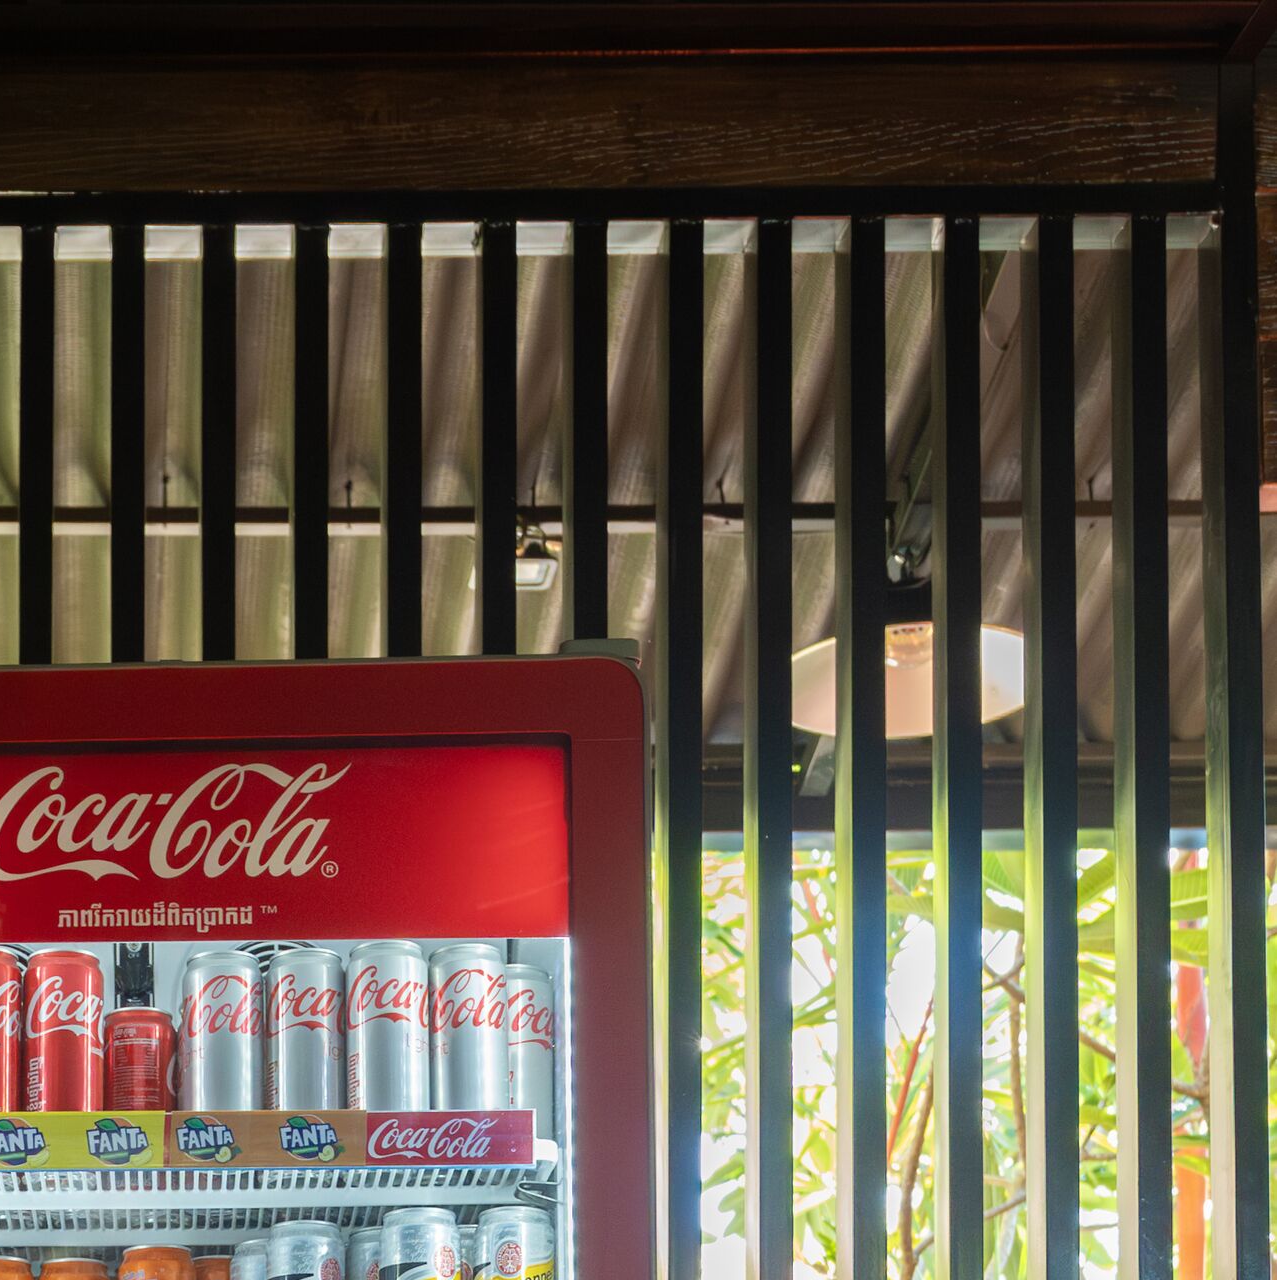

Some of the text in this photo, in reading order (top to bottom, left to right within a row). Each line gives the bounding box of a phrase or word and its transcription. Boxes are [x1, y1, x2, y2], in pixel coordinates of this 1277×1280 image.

[87, 1127, 148, 1156] FANTA
[176, 1125, 234, 1151] FANTA
[280, 1124, 337, 1151] FANTA
[367, 1117, 498, 1160] Coca-Cola
